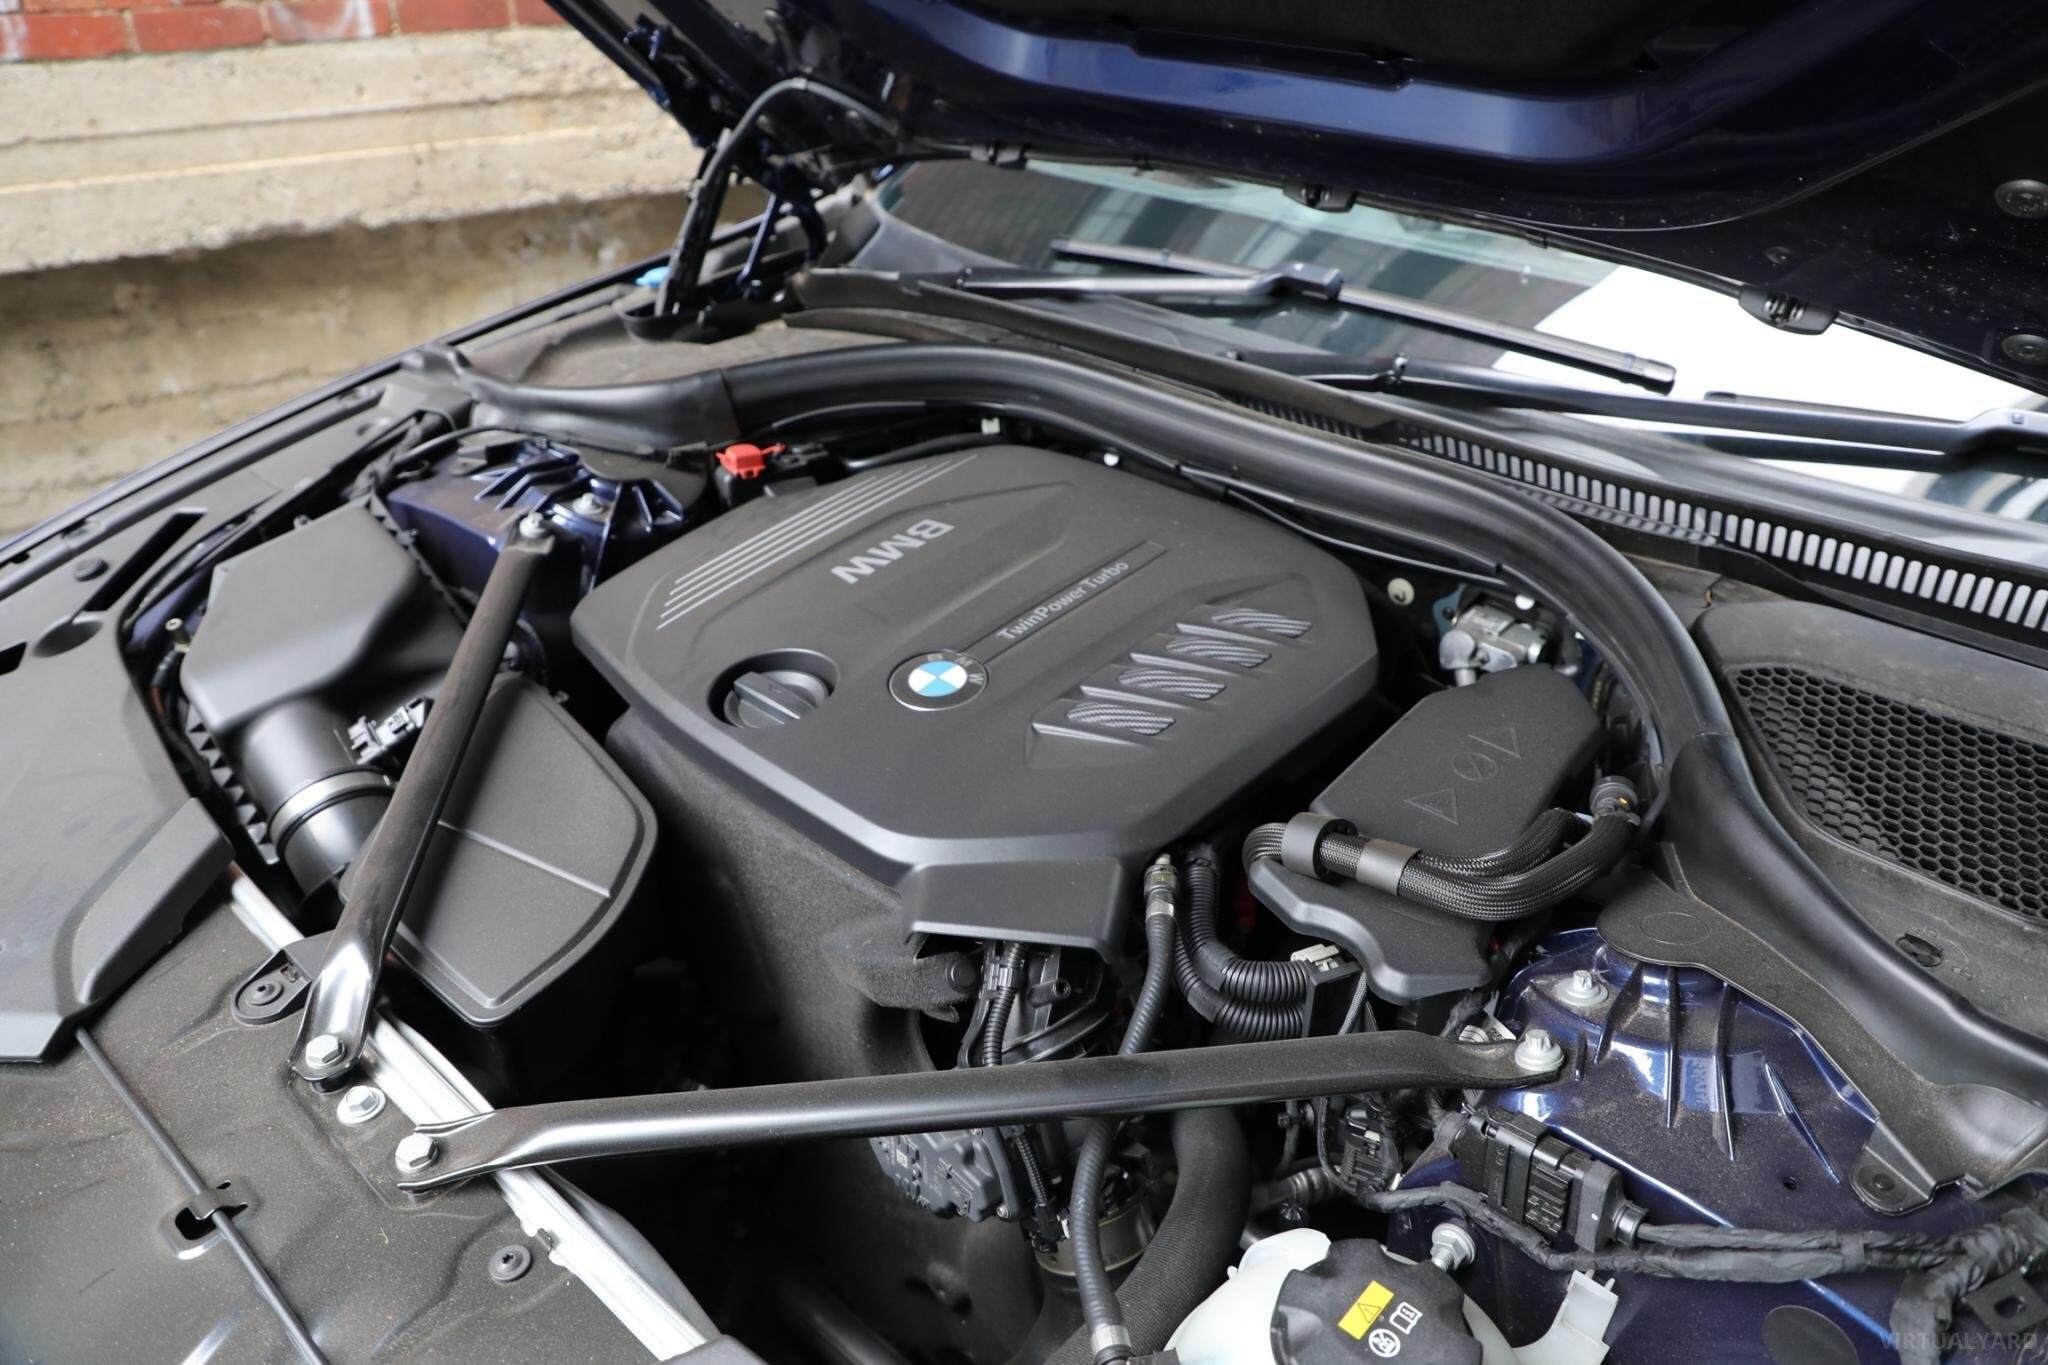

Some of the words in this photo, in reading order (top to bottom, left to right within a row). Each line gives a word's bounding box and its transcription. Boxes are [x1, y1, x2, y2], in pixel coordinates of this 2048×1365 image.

[831, 518, 955, 584] BMW
[996, 586, 1088, 640] TwinPower
[1080, 561, 1129, 589] Turbo
[927, 653, 984, 685] BMW
